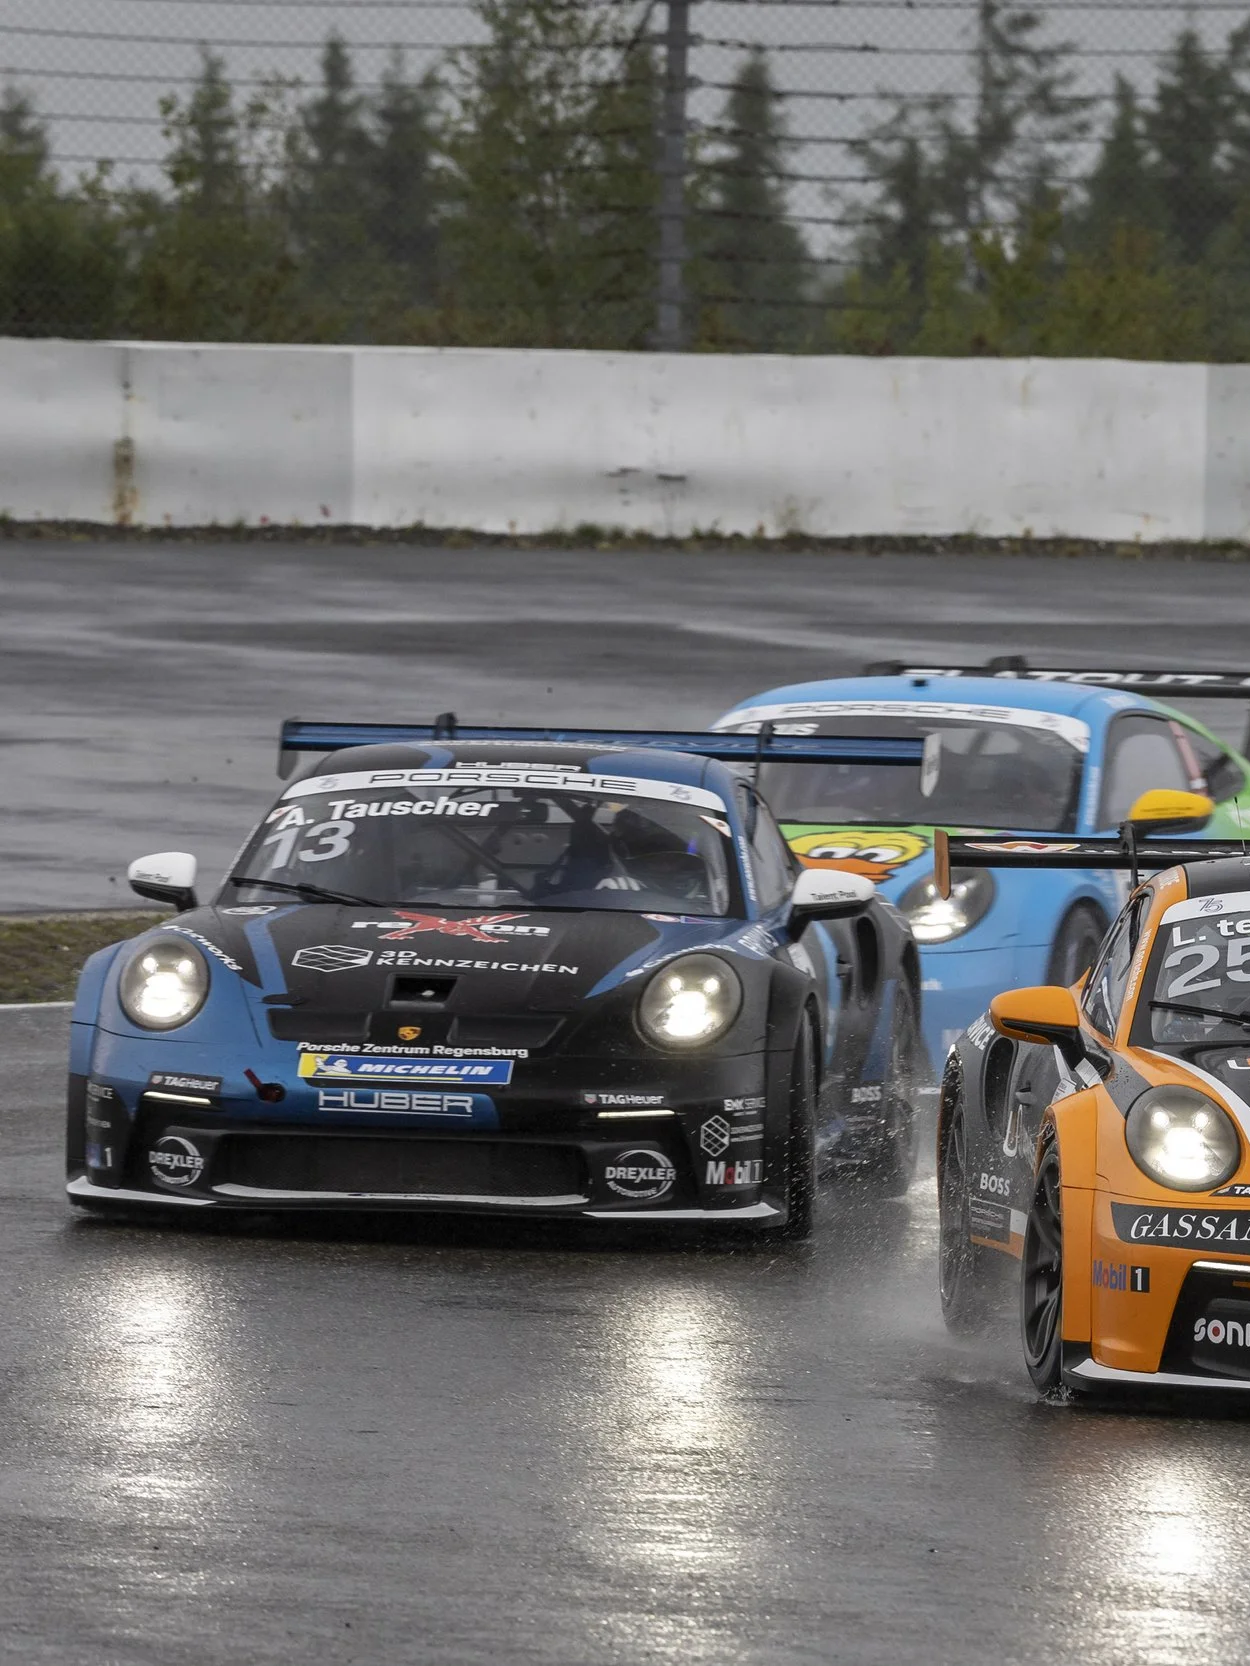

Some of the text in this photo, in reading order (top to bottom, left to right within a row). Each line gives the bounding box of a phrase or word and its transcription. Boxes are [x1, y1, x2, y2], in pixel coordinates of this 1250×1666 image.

[782, 703, 1011, 720] PORSCHE
[369, 772, 637, 792] PORSCHE
[276, 796, 499, 830] A. Tauscher
[263, 820, 356, 869] 13
[1172, 926, 1207, 947] L.
[380, 950, 418, 959] 3D
[376, 957, 580, 975] KENNZEICHEN
[297, 1041, 529, 1058] Porsche Zentrum Regensburg
[357, 1062, 494, 1077] MICHELIN
[318, 1090, 473, 1113] HUBER
[149, 1150, 204, 1170] DREXLER
[605, 1165, 676, 1183] DREXLER
[705, 1160, 751, 1185] Mobil
[980, 1172, 1011, 1196] BOSS
[1093, 1260, 1127, 1291] Mobil
